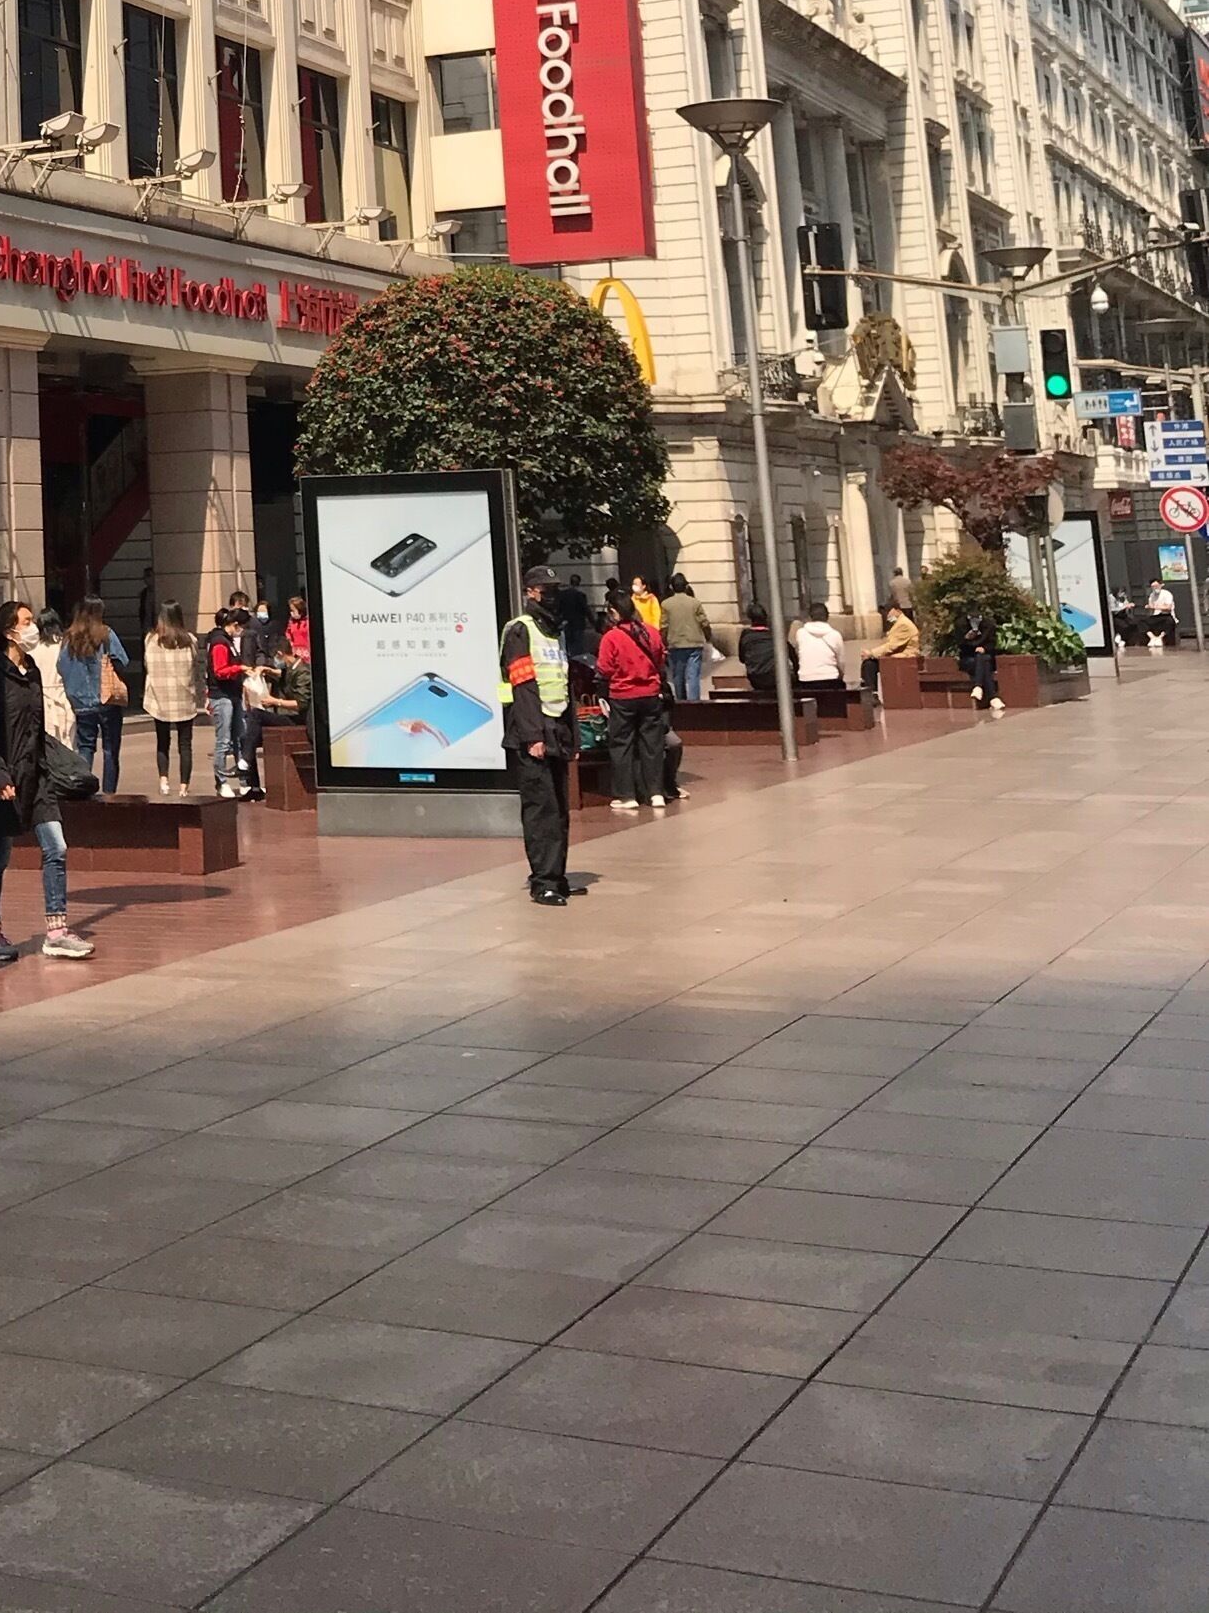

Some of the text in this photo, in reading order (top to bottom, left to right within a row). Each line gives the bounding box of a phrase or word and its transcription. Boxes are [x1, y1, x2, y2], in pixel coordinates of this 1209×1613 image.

[536, 1, 593, 217] Foodhall
[120, 257, 167, 306] First
[170, 266, 268, 321] Foodhall
[351, 613, 402, 624] HUAWEI
[406, 613, 425, 623] P40
[453, 612, 469, 624] 5G
